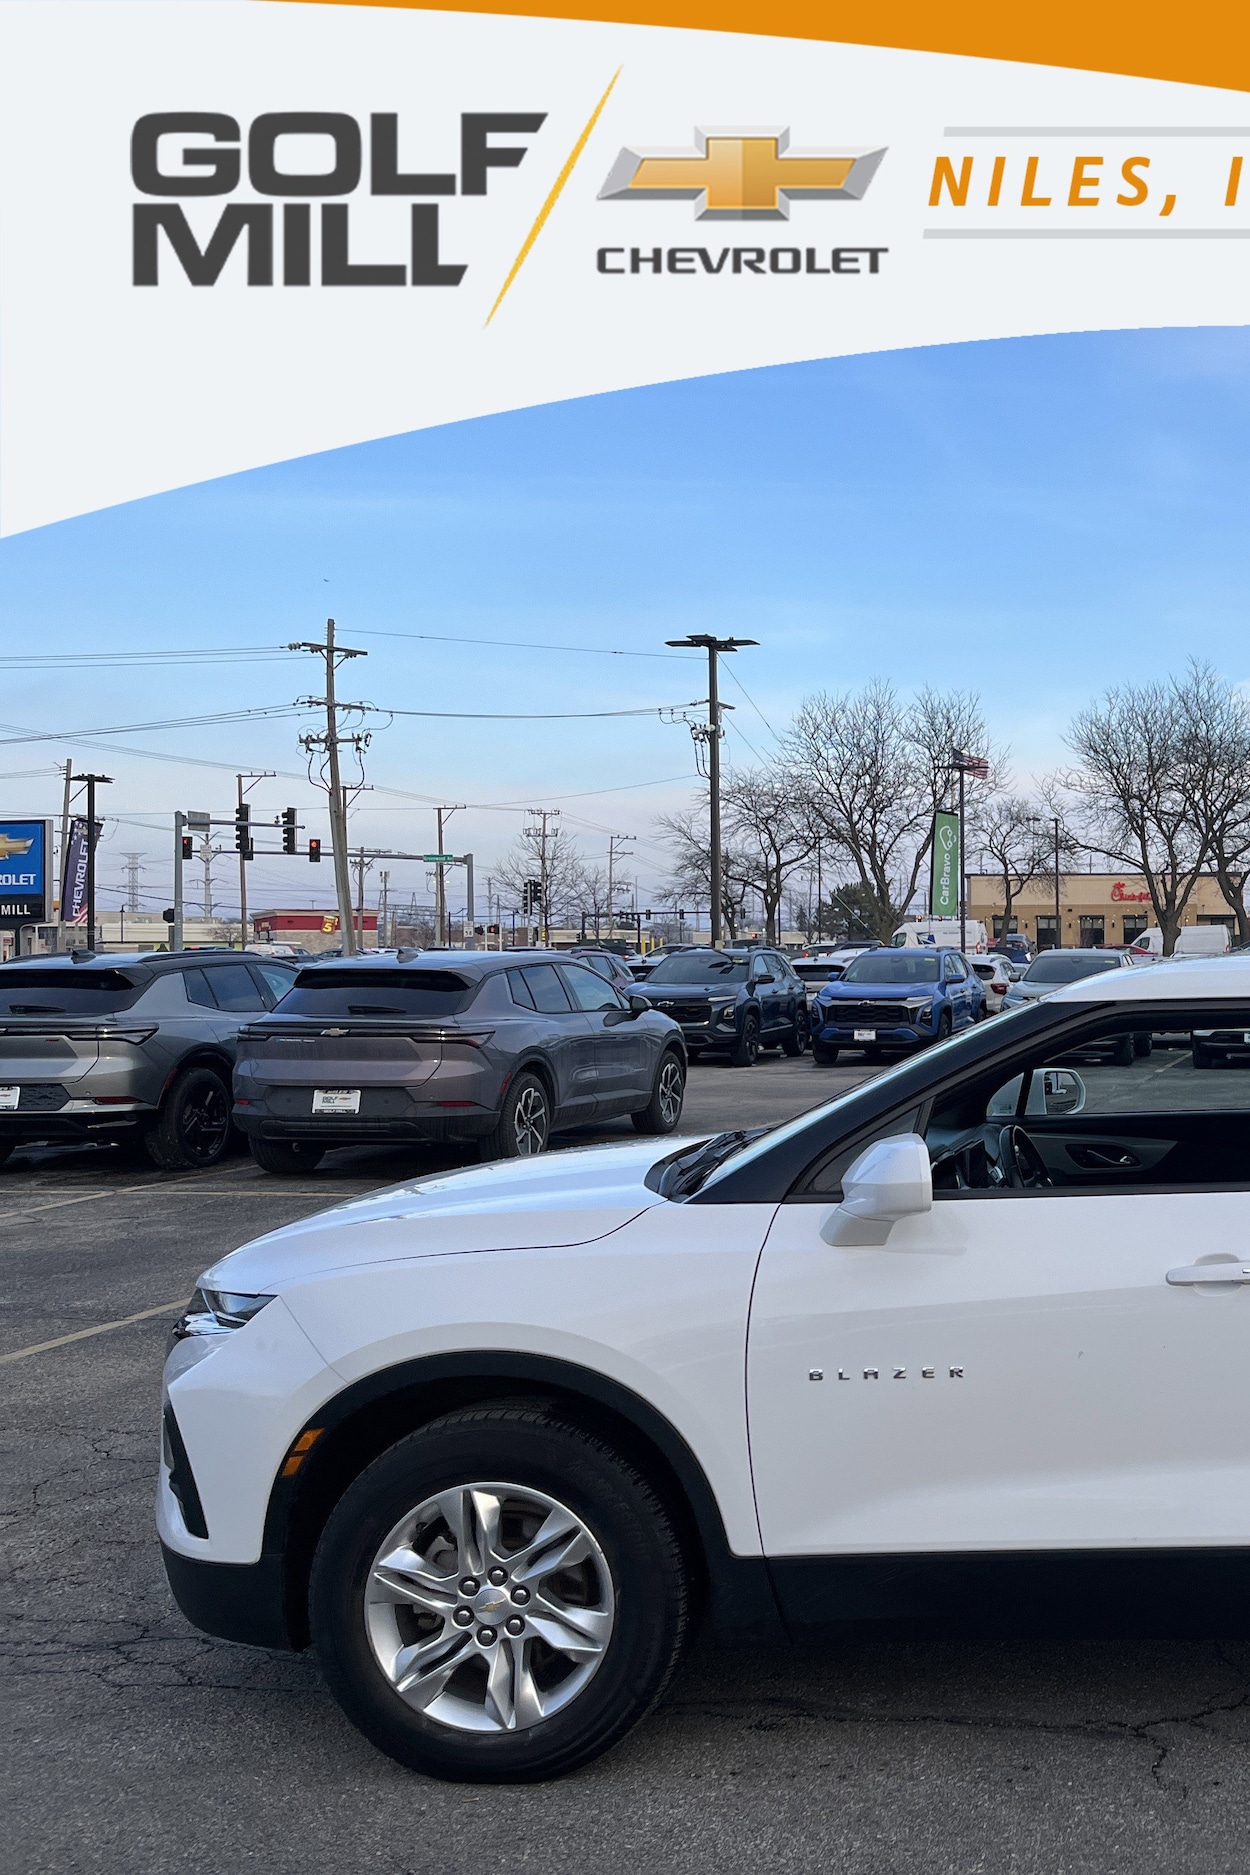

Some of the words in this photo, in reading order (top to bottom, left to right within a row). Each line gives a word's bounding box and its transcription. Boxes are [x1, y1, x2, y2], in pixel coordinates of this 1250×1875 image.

[940, 853, 951, 905] CarBravo
[1, 904, 31, 915] MILL
[322, 922, 332, 932] 5
[808, 1366, 965, 1381] BLAZER
